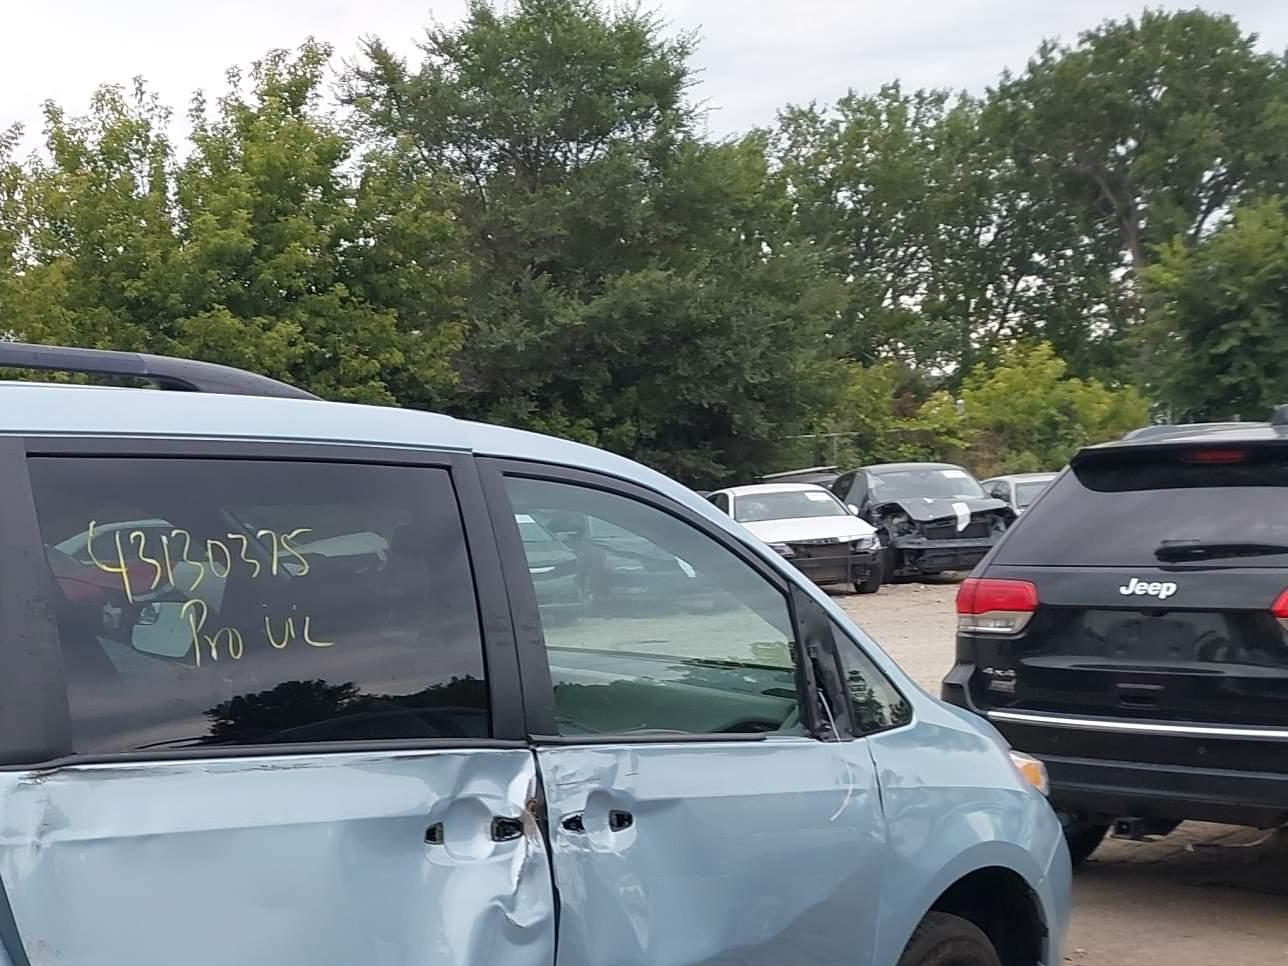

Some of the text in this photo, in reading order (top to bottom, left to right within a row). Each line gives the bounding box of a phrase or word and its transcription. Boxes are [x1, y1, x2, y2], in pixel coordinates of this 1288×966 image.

[88, 520, 313, 603] 43130375
[1119, 577, 1177, 600] Jeep
[180, 598, 243, 667] Pro
